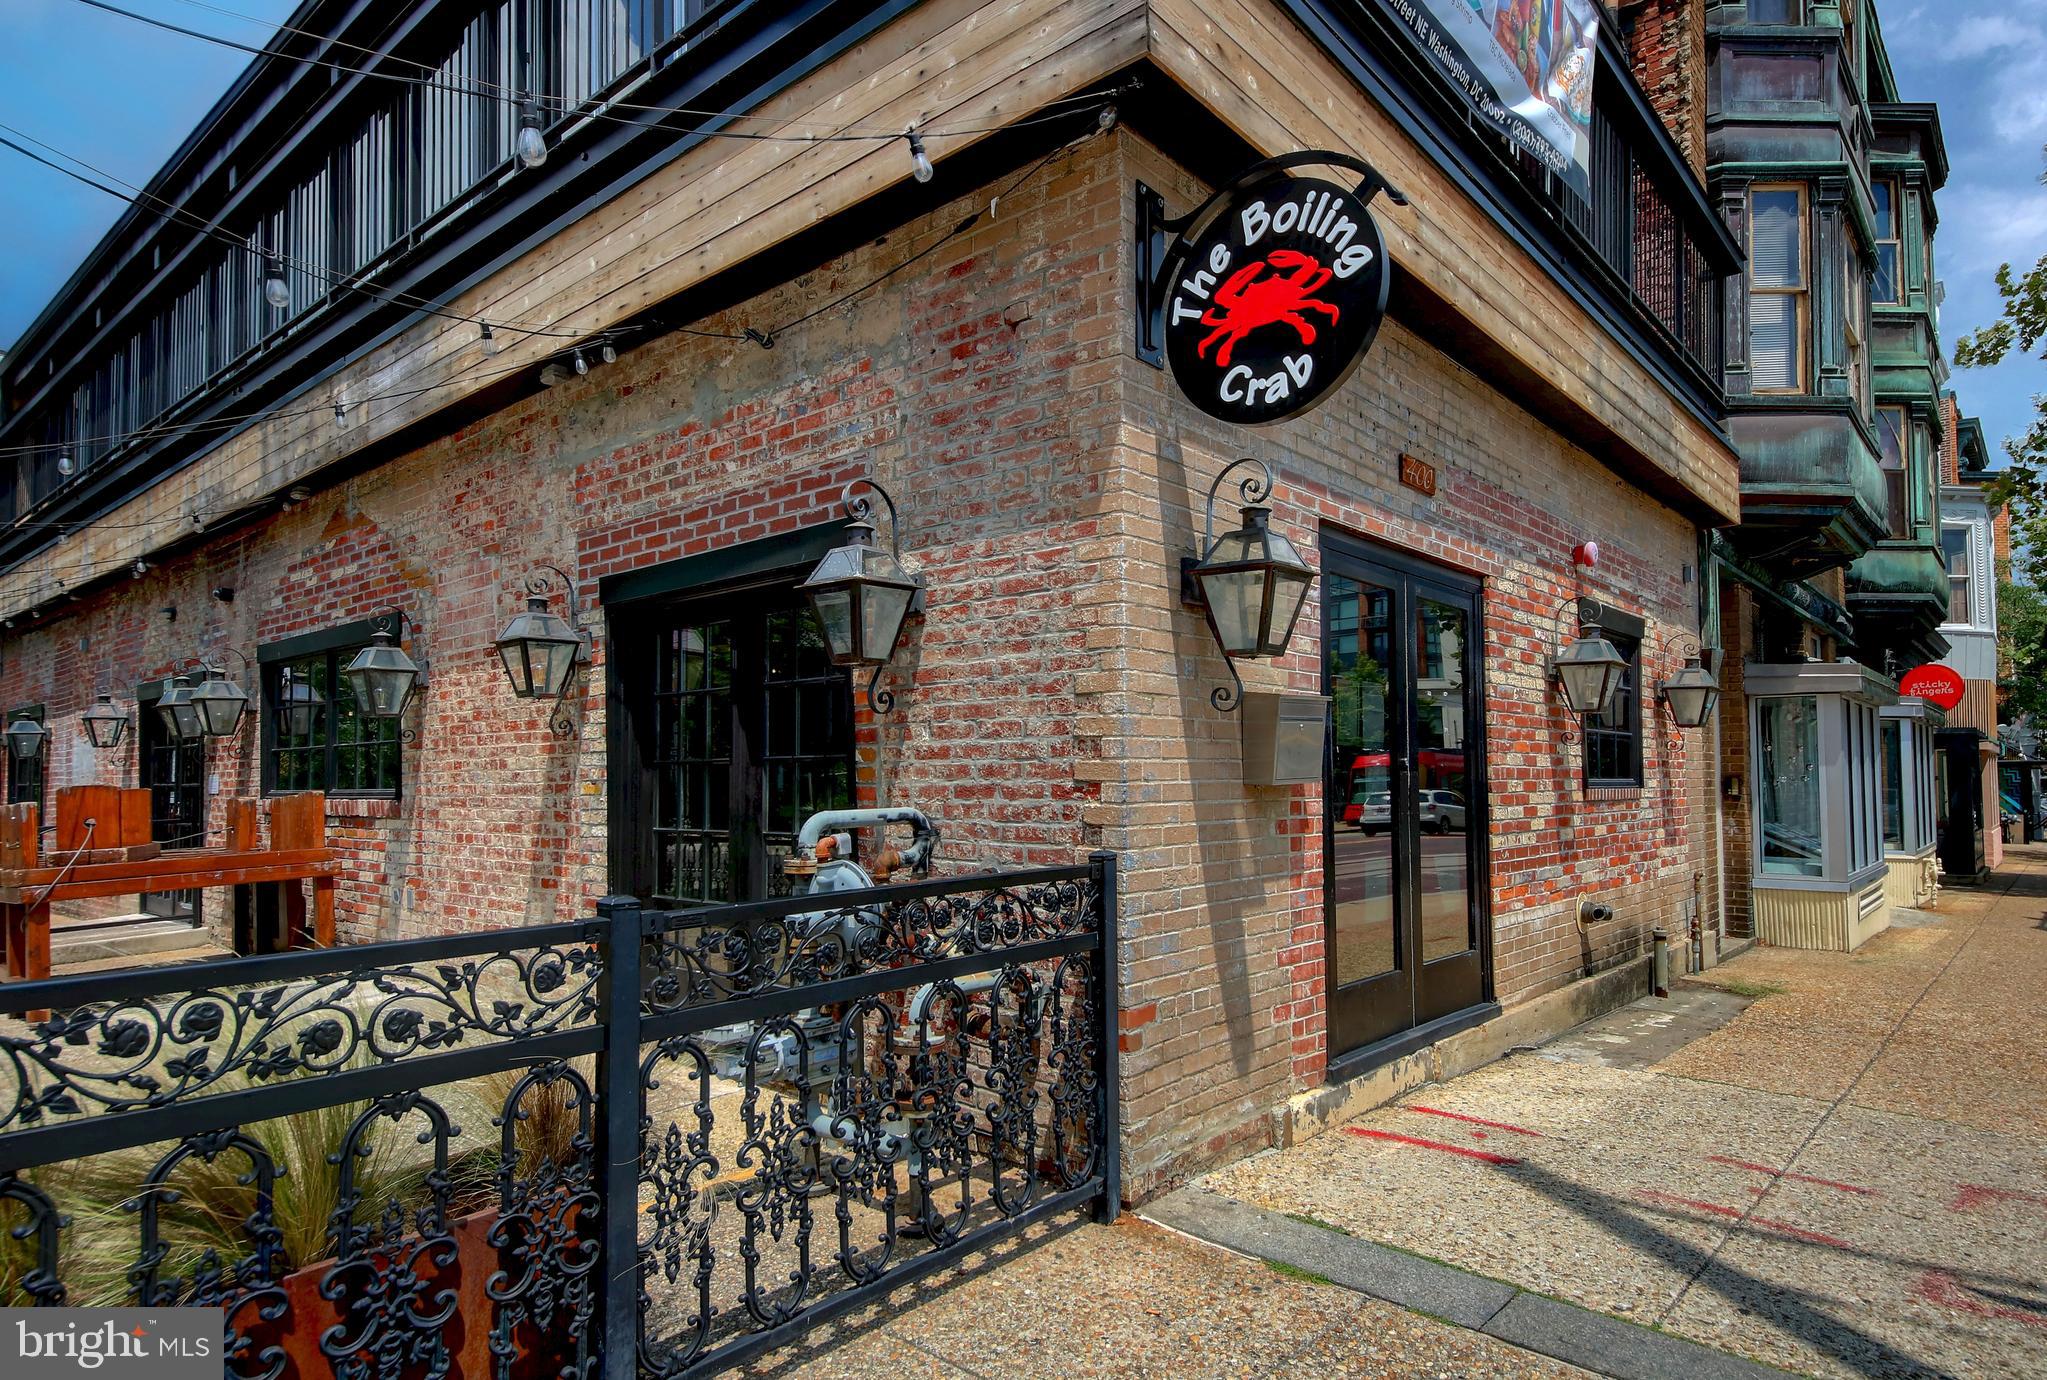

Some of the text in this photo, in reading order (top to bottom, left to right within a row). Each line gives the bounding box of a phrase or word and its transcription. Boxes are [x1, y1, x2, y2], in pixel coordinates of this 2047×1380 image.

[1390, 0, 1417, 26] reet
[1414, 14, 1429, 40] NE
[1427, 28, 1470, 92] Washington,
[1469, 79, 1483, 102] DC
[1480, 92, 1506, 124] 20002
[1172, 190, 1374, 326] The Boiling
[1220, 353, 1313, 406] Crab
[1912, 680, 1951, 689] sticky
